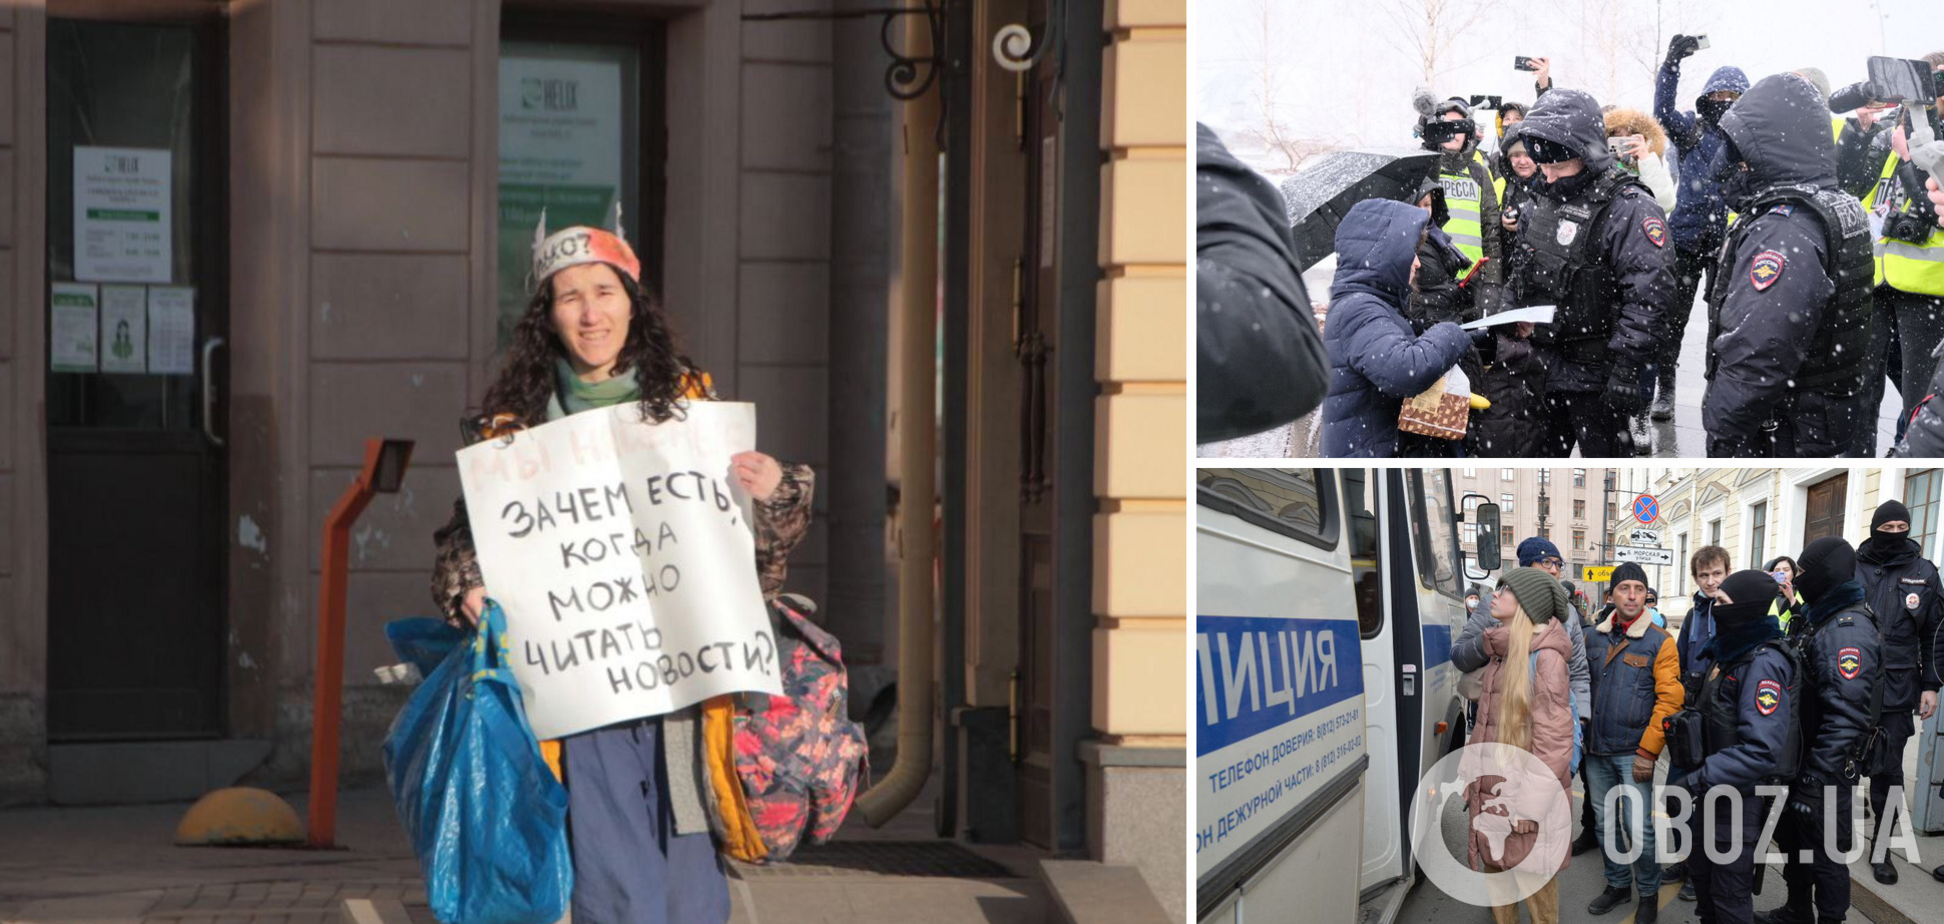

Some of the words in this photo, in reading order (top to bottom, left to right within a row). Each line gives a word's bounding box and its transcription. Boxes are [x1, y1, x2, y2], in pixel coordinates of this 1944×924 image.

[501, 482, 633, 538] ЗАЧЕМ
[560, 521, 678, 569] КОГДА
[547, 563, 680, 621] МОЖНО
[525, 620, 662, 675] ЧИТАТЬ
[606, 630, 775, 695] НОВОСТИ?
[1209, 749, 1270, 793] ТЕЛЕФОН
[1272, 729, 1316, 766] ДОВЕРИЯ:
[1217, 780, 1283, 842] ДЕЖУРНОЙ
[1284, 763, 1315, 791] ЧАСТИ:
